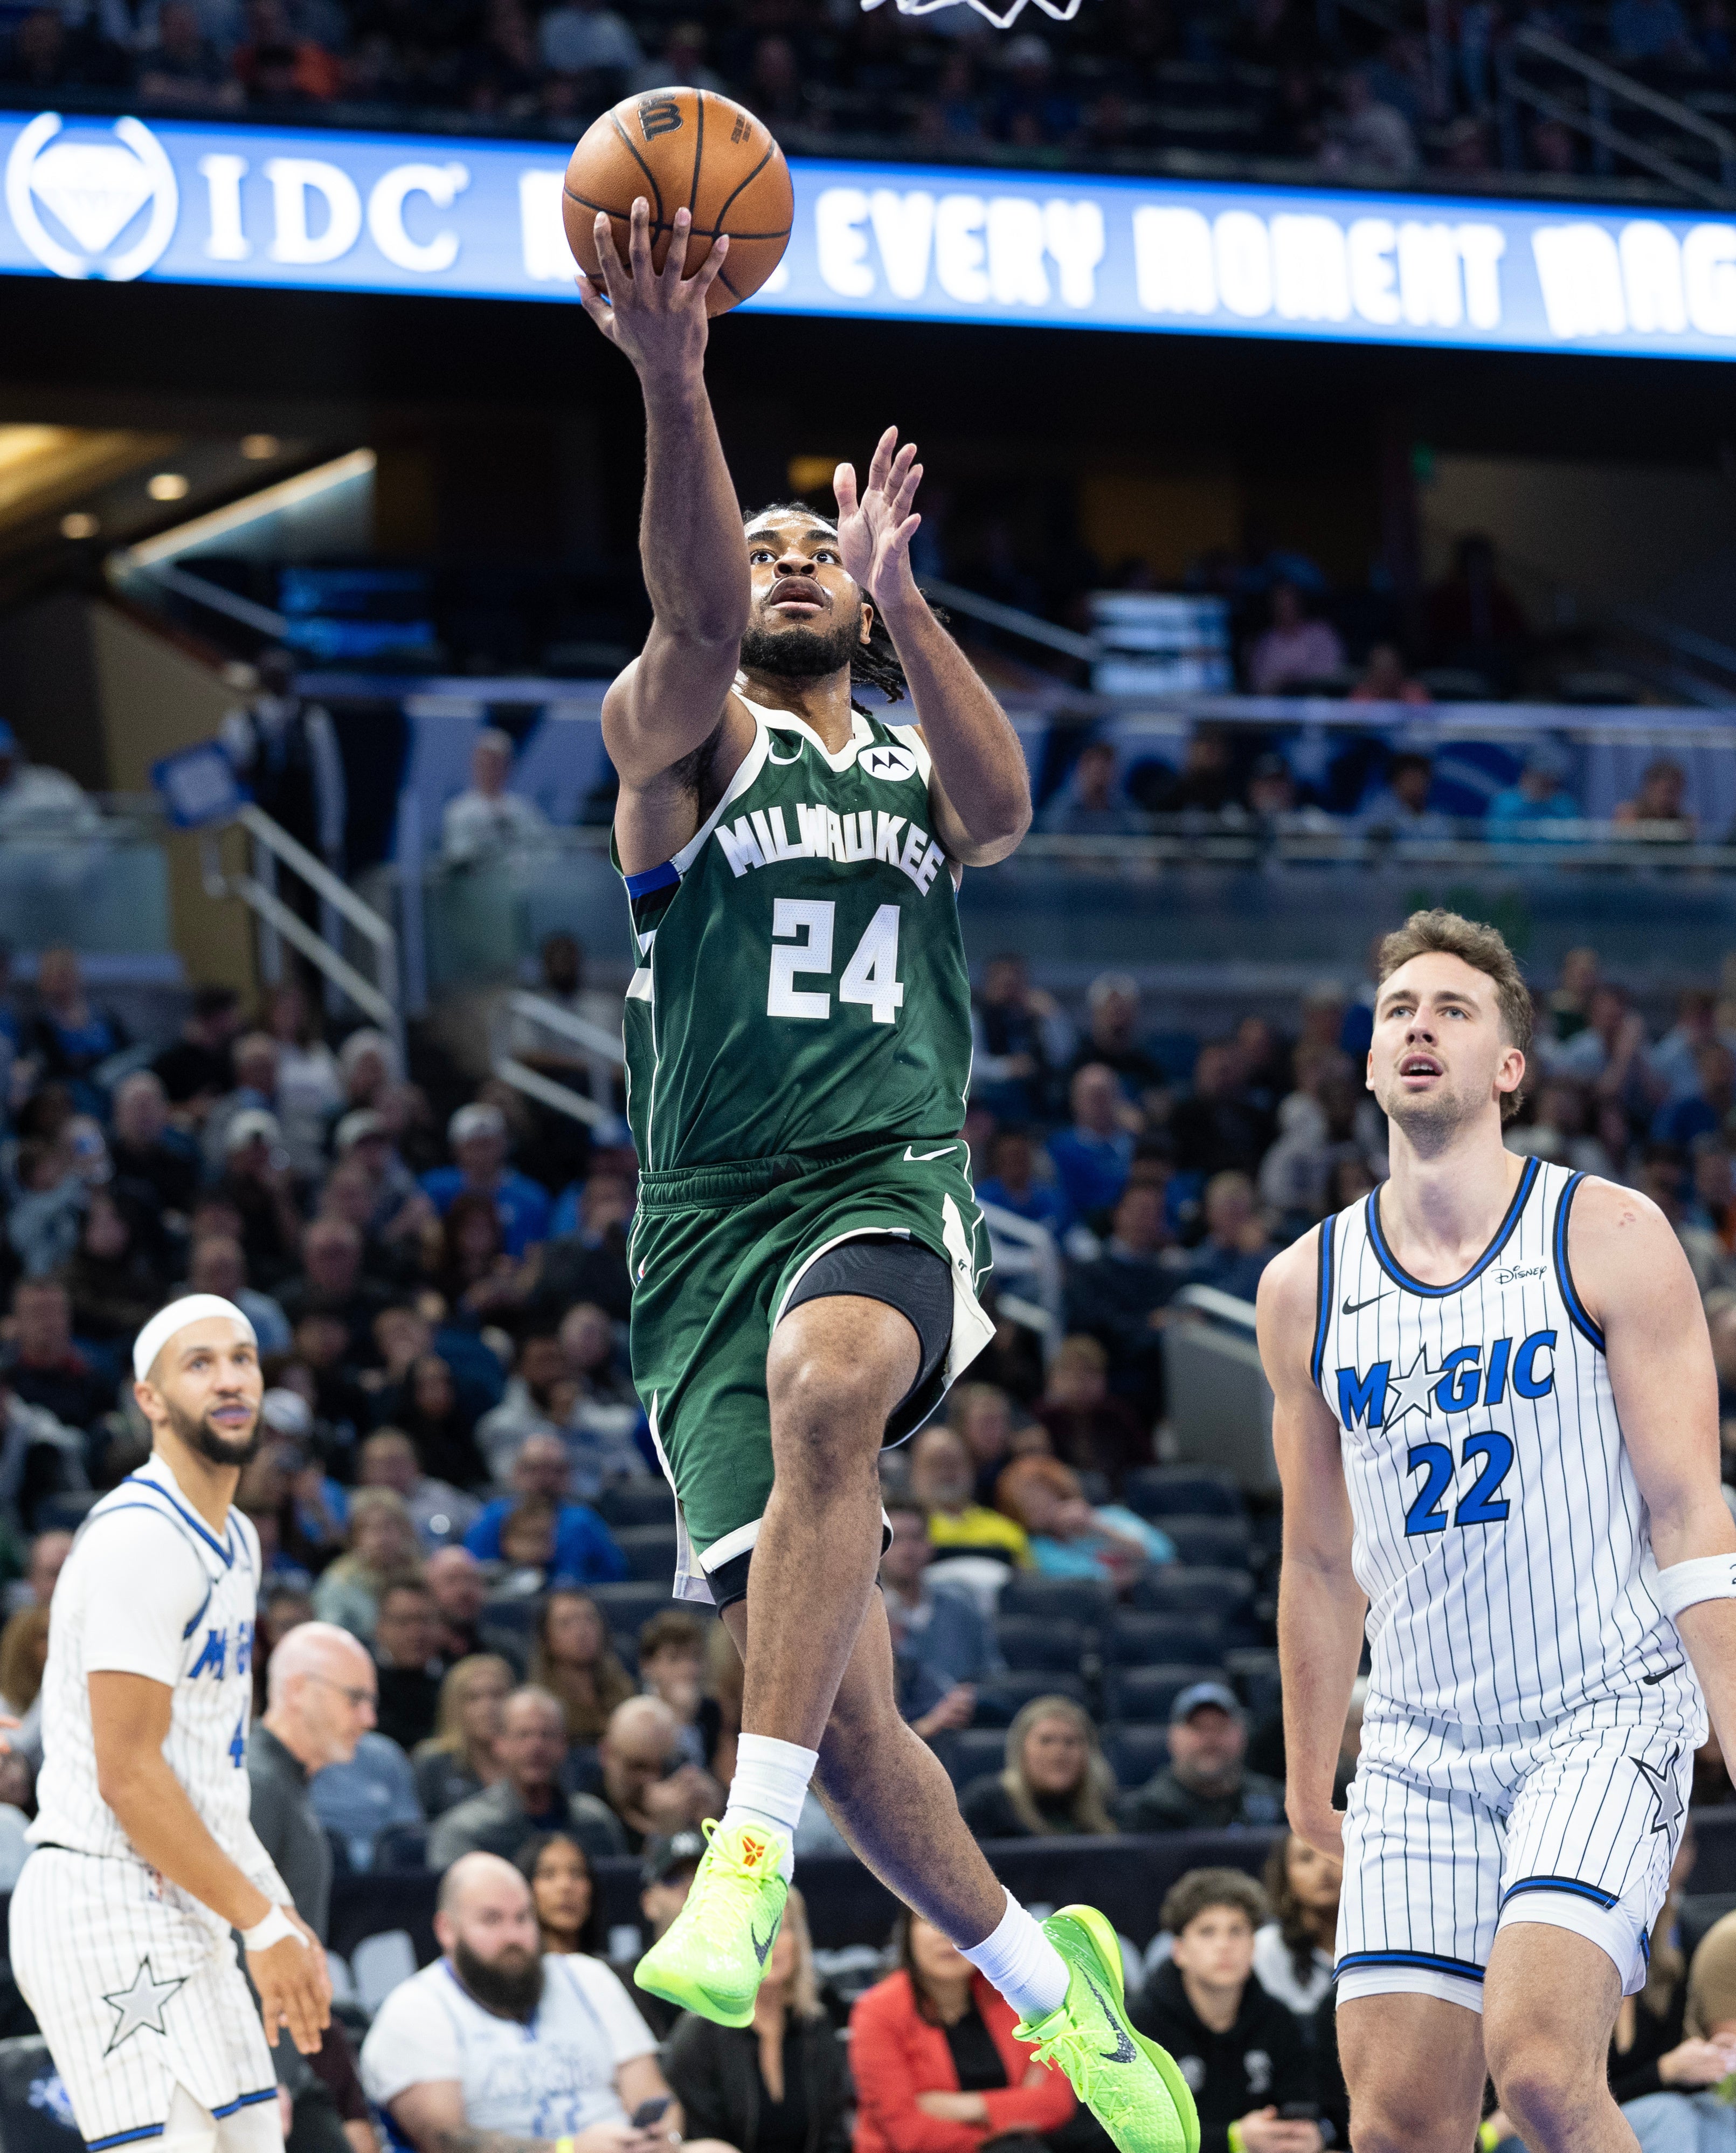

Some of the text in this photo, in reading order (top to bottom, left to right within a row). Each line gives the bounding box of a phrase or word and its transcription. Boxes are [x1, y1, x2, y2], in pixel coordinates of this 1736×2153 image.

[203, 155, 468, 273] IDC
[815, 189, 1105, 309] EVERY
[714, 804, 945, 896] MILWAUKEE
[767, 898, 903, 1024] 24
[1404, 1431, 1514, 1537] 22
